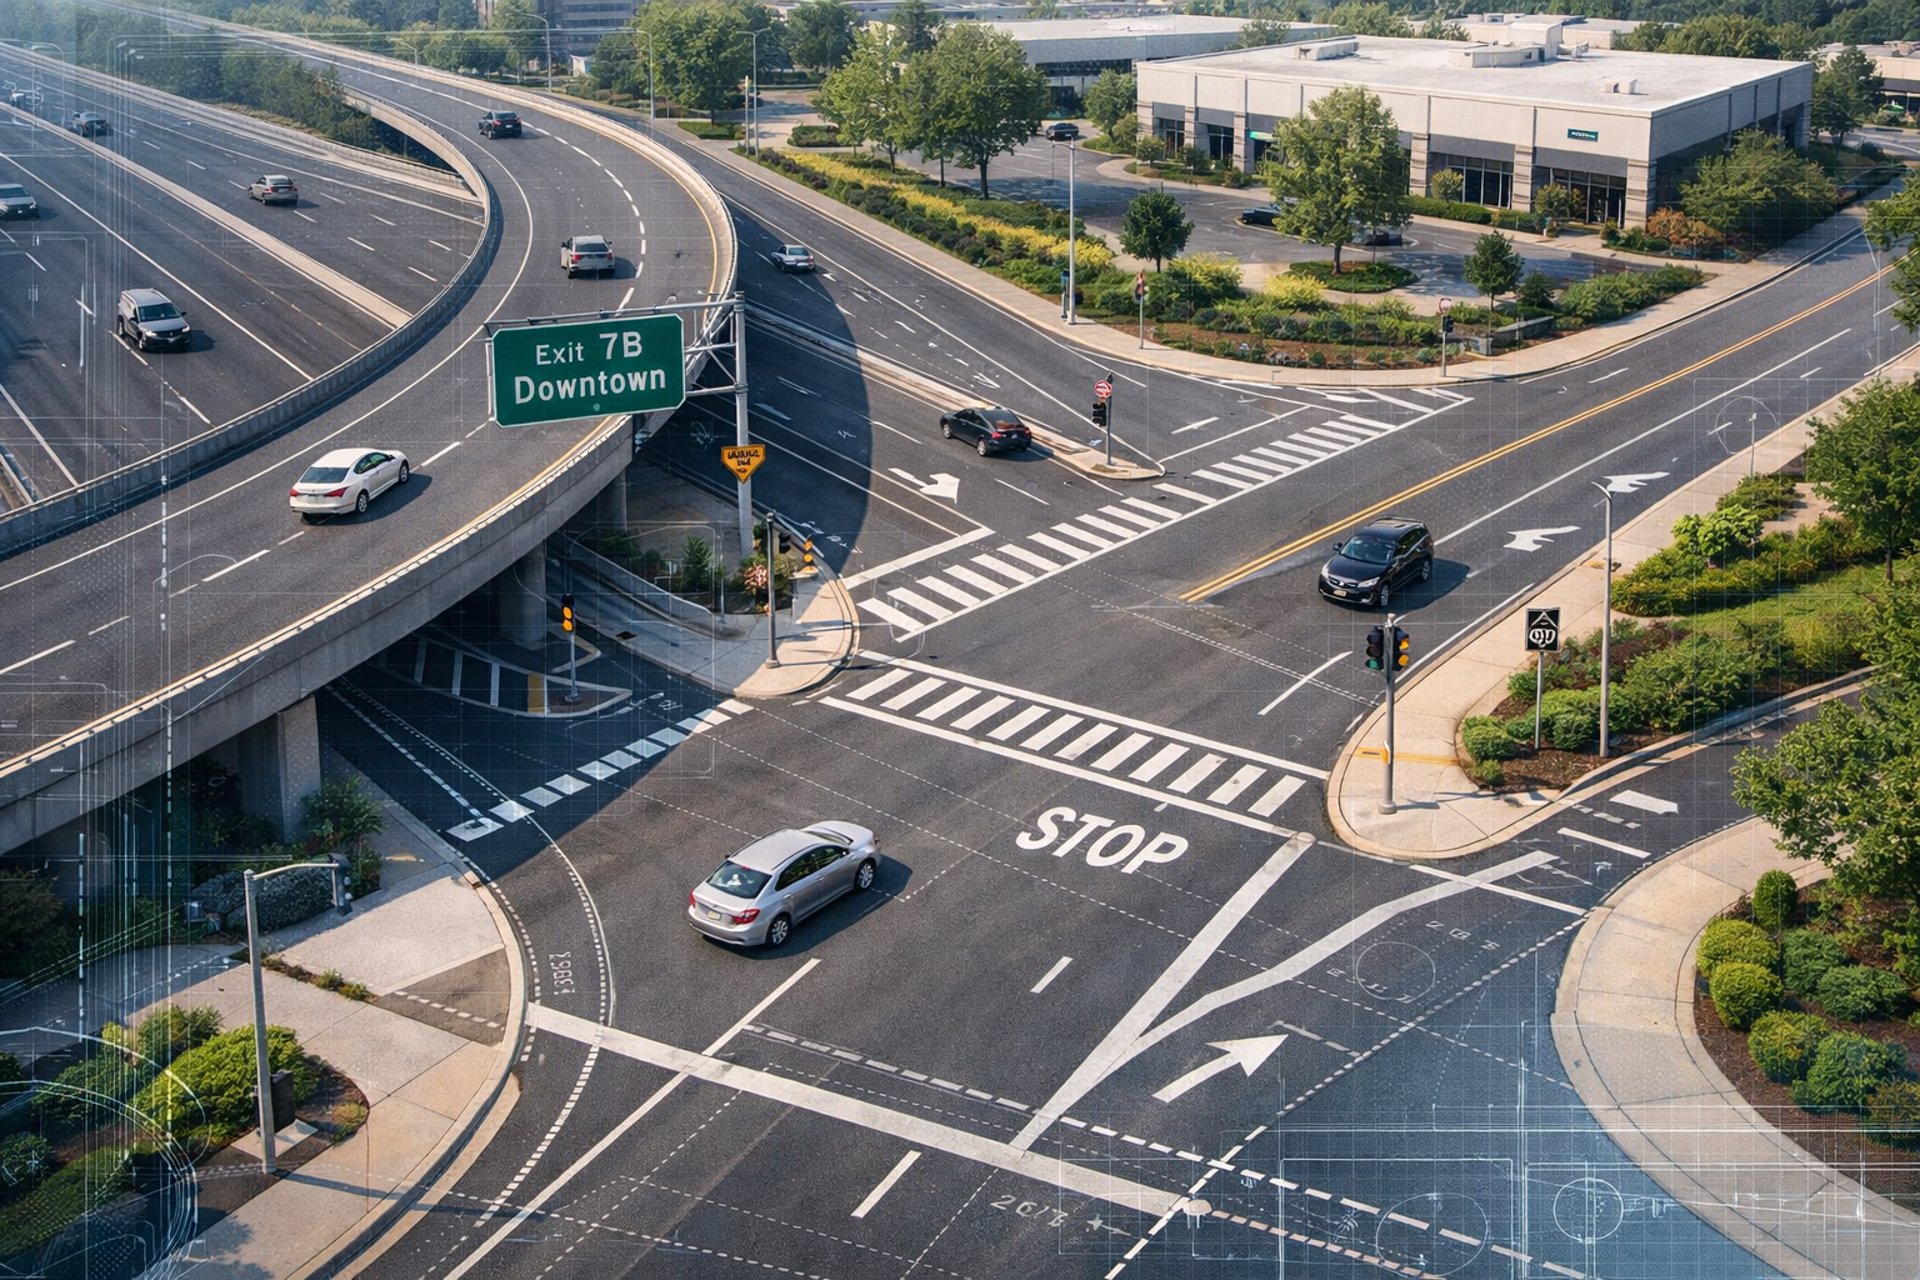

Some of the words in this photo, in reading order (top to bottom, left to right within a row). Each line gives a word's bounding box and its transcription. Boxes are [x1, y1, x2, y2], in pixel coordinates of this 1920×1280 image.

[536, 342, 584, 365] Exit
[599, 331, 643, 360] 7B
[514, 368, 666, 405] Downtown
[1015, 806, 1189, 874] STOP
